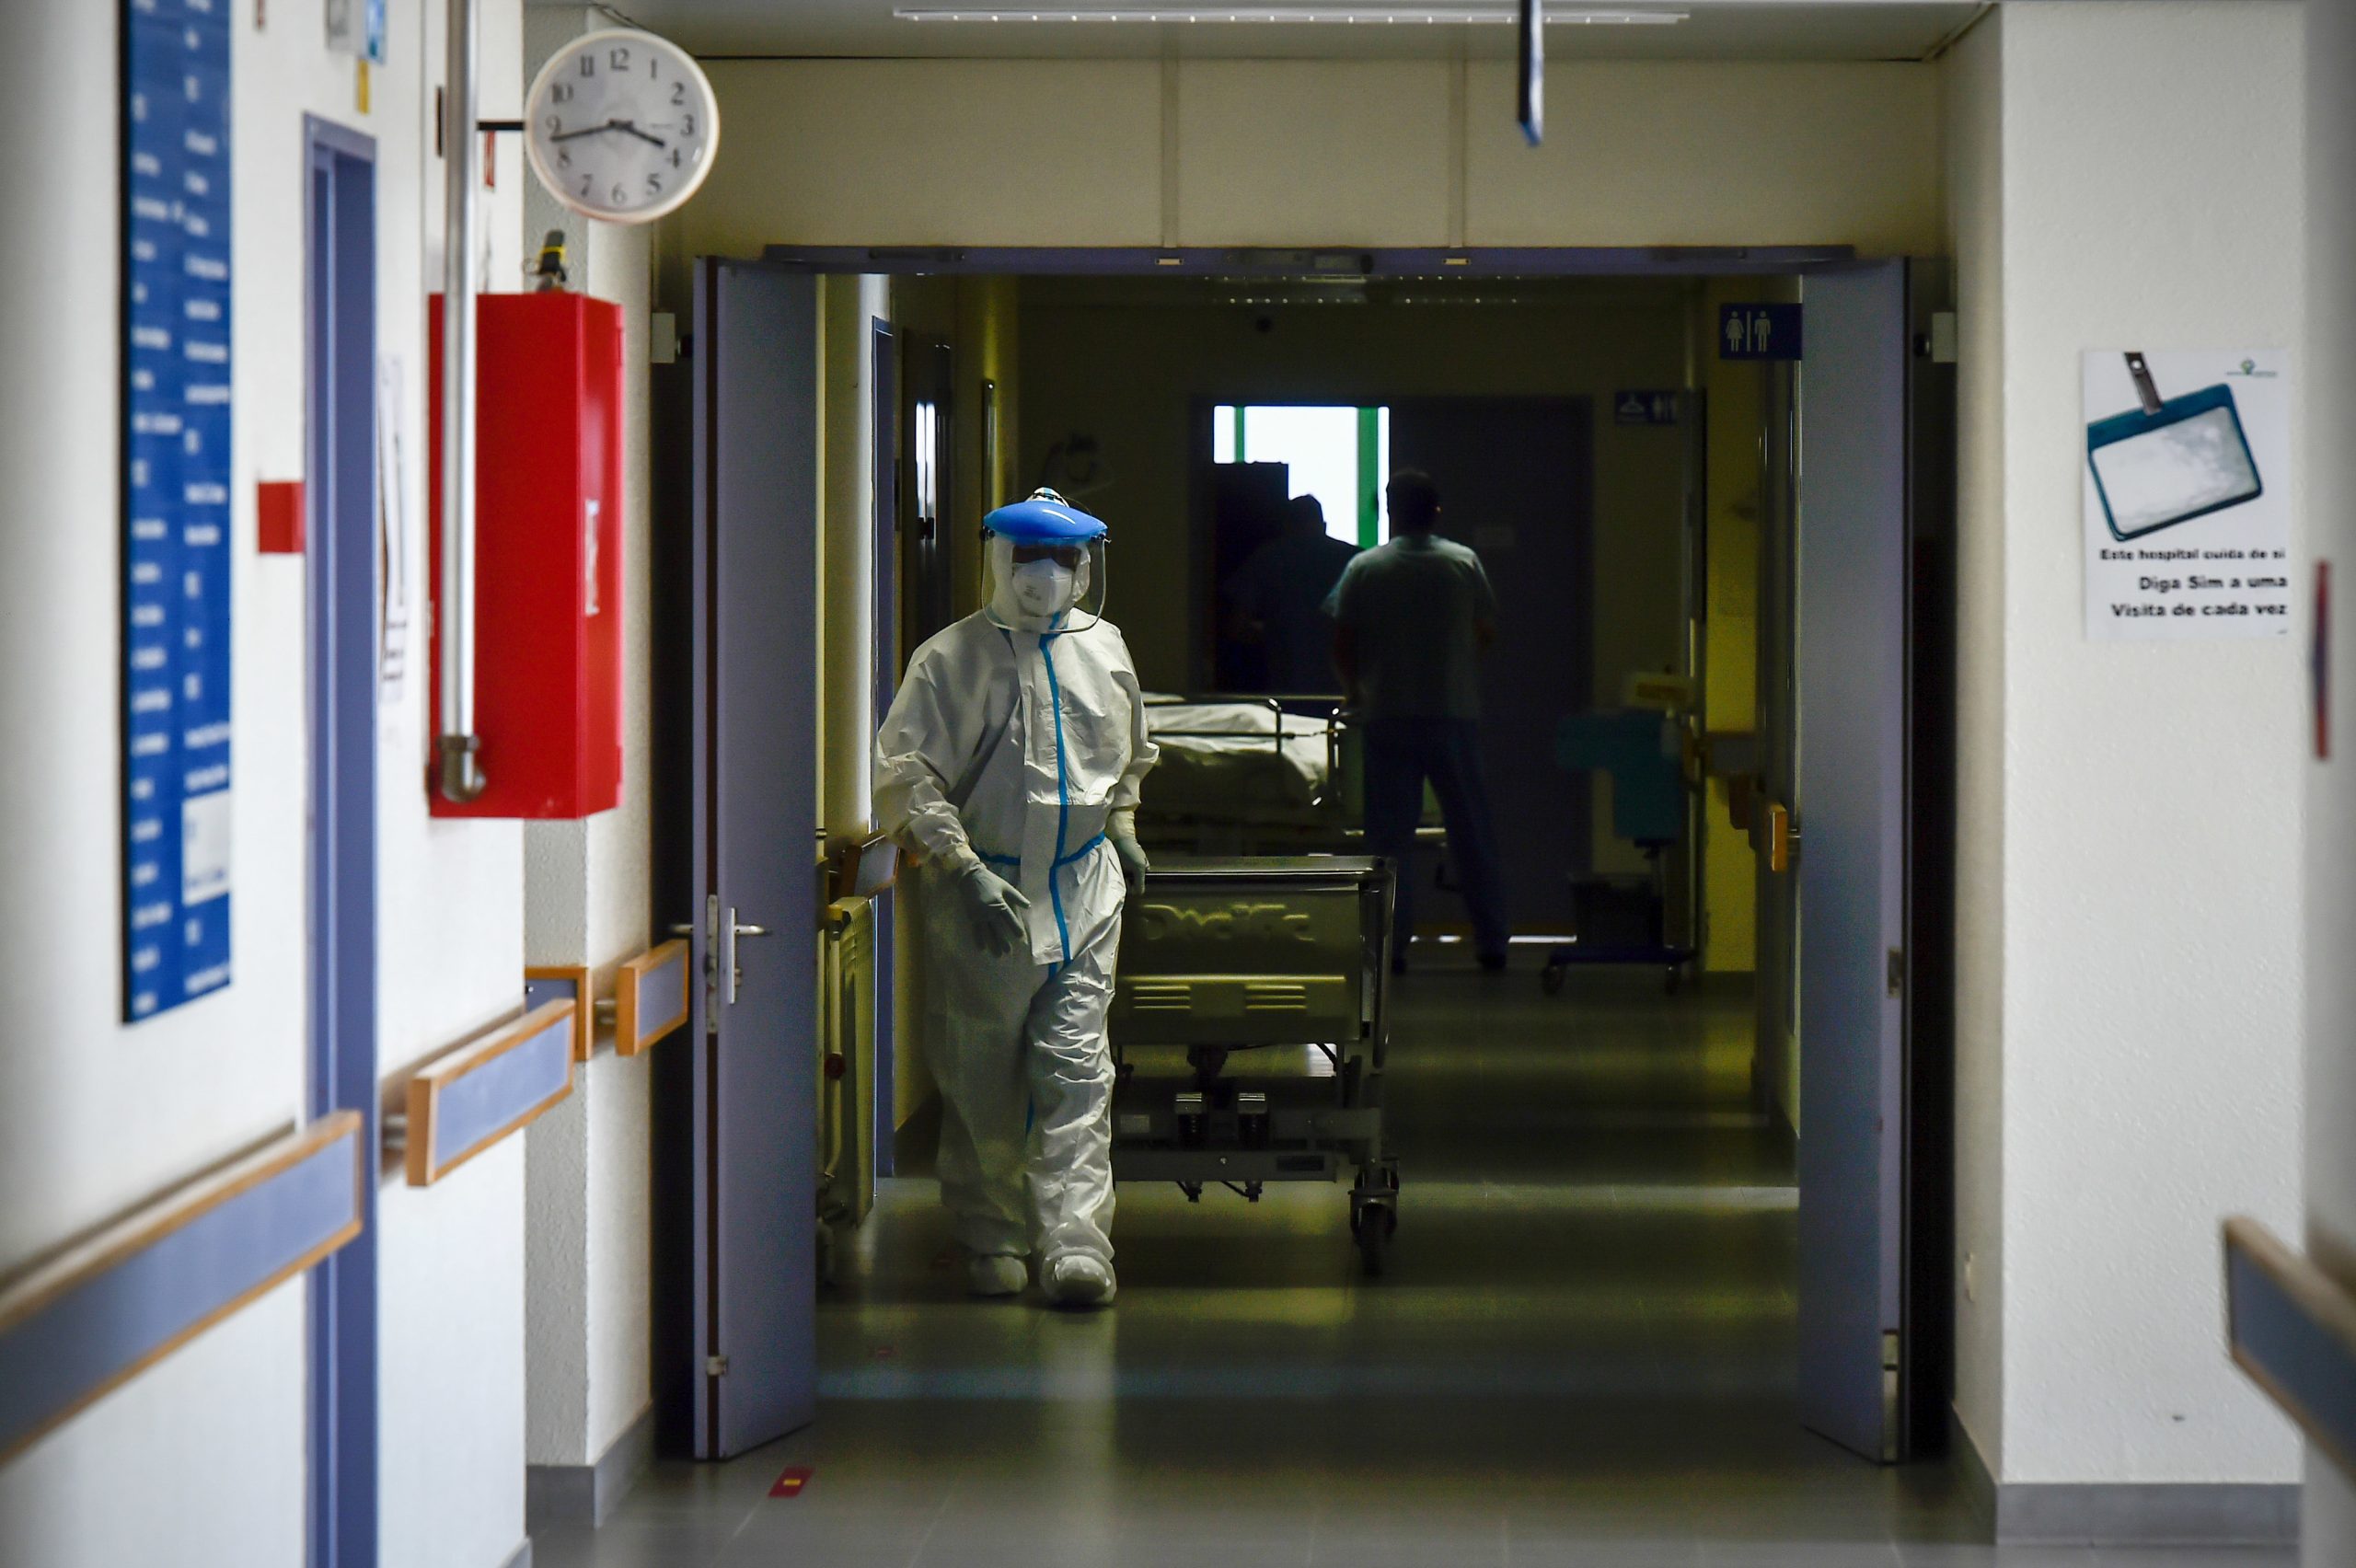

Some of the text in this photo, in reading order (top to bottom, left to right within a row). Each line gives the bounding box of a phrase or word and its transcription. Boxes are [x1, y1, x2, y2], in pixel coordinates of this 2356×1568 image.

[611, 48, 629, 72] 12
[650, 58, 657, 81] 1
[671, 82, 686, 106] 2
[680, 114, 694, 136] 3
[581, 173, 594, 197] 7
[647, 173, 661, 196] 5
[2100, 548, 2134, 560] Este
[2139, 548, 2200, 562] hospital
[2140, 575, 2288, 594] Diga Sim a uma
[2111, 602, 2288, 617] Visita de cada vez
